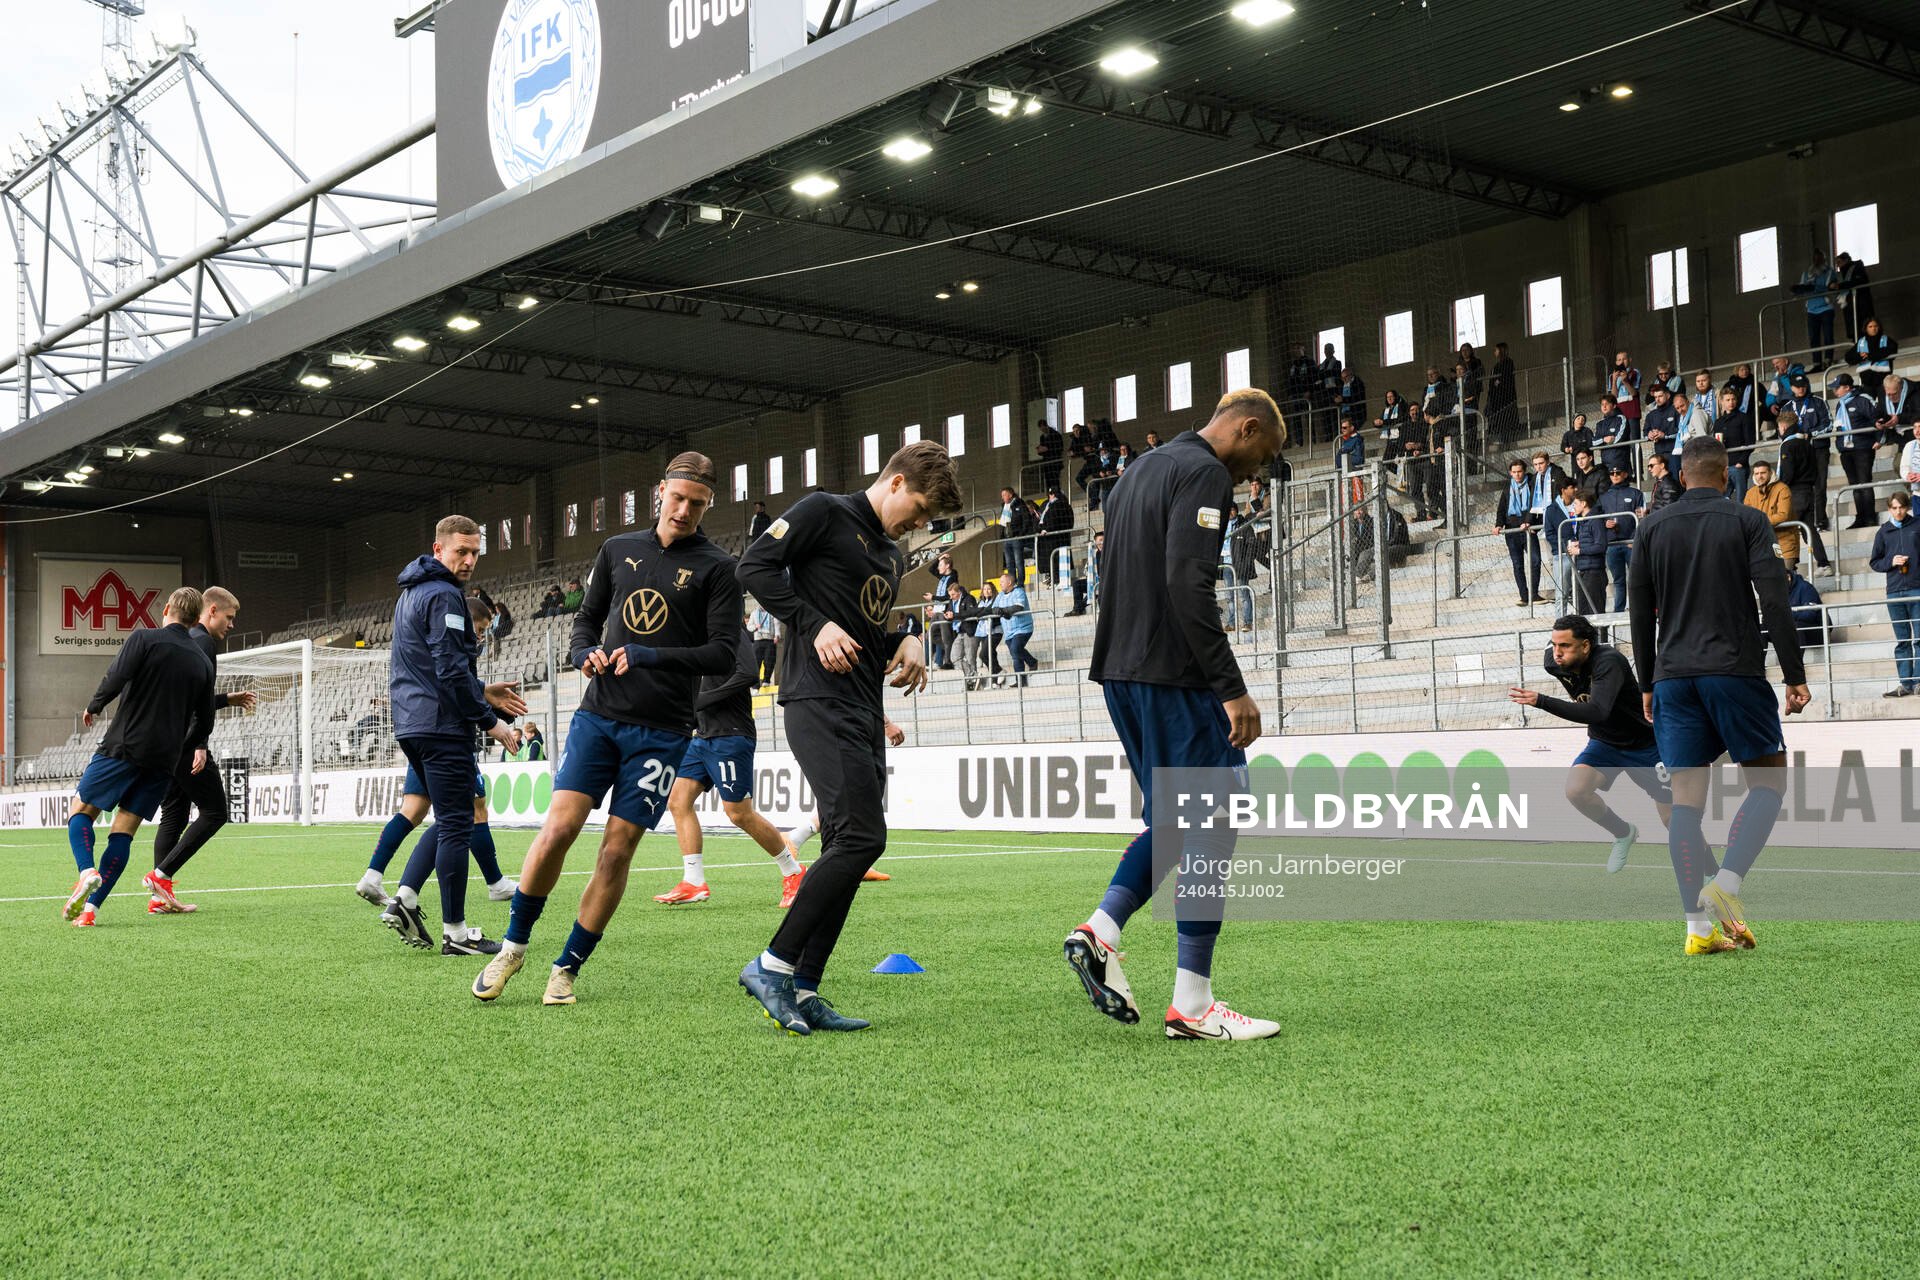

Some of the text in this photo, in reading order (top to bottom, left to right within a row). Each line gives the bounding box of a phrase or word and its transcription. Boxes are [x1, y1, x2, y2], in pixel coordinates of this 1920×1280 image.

[521, 11, 562, 62] IFK
[61, 568, 162, 632] MAX
[54, 635, 124, 648] Sveriges godast
[637, 758, 676, 797] 20
[718, 760, 737, 782] 11
[40, 796, 75, 826] UNIB
[230, 769, 246, 823] SELECT
[254, 786, 281, 816] HOS
[355, 775, 405, 817] UNIB
